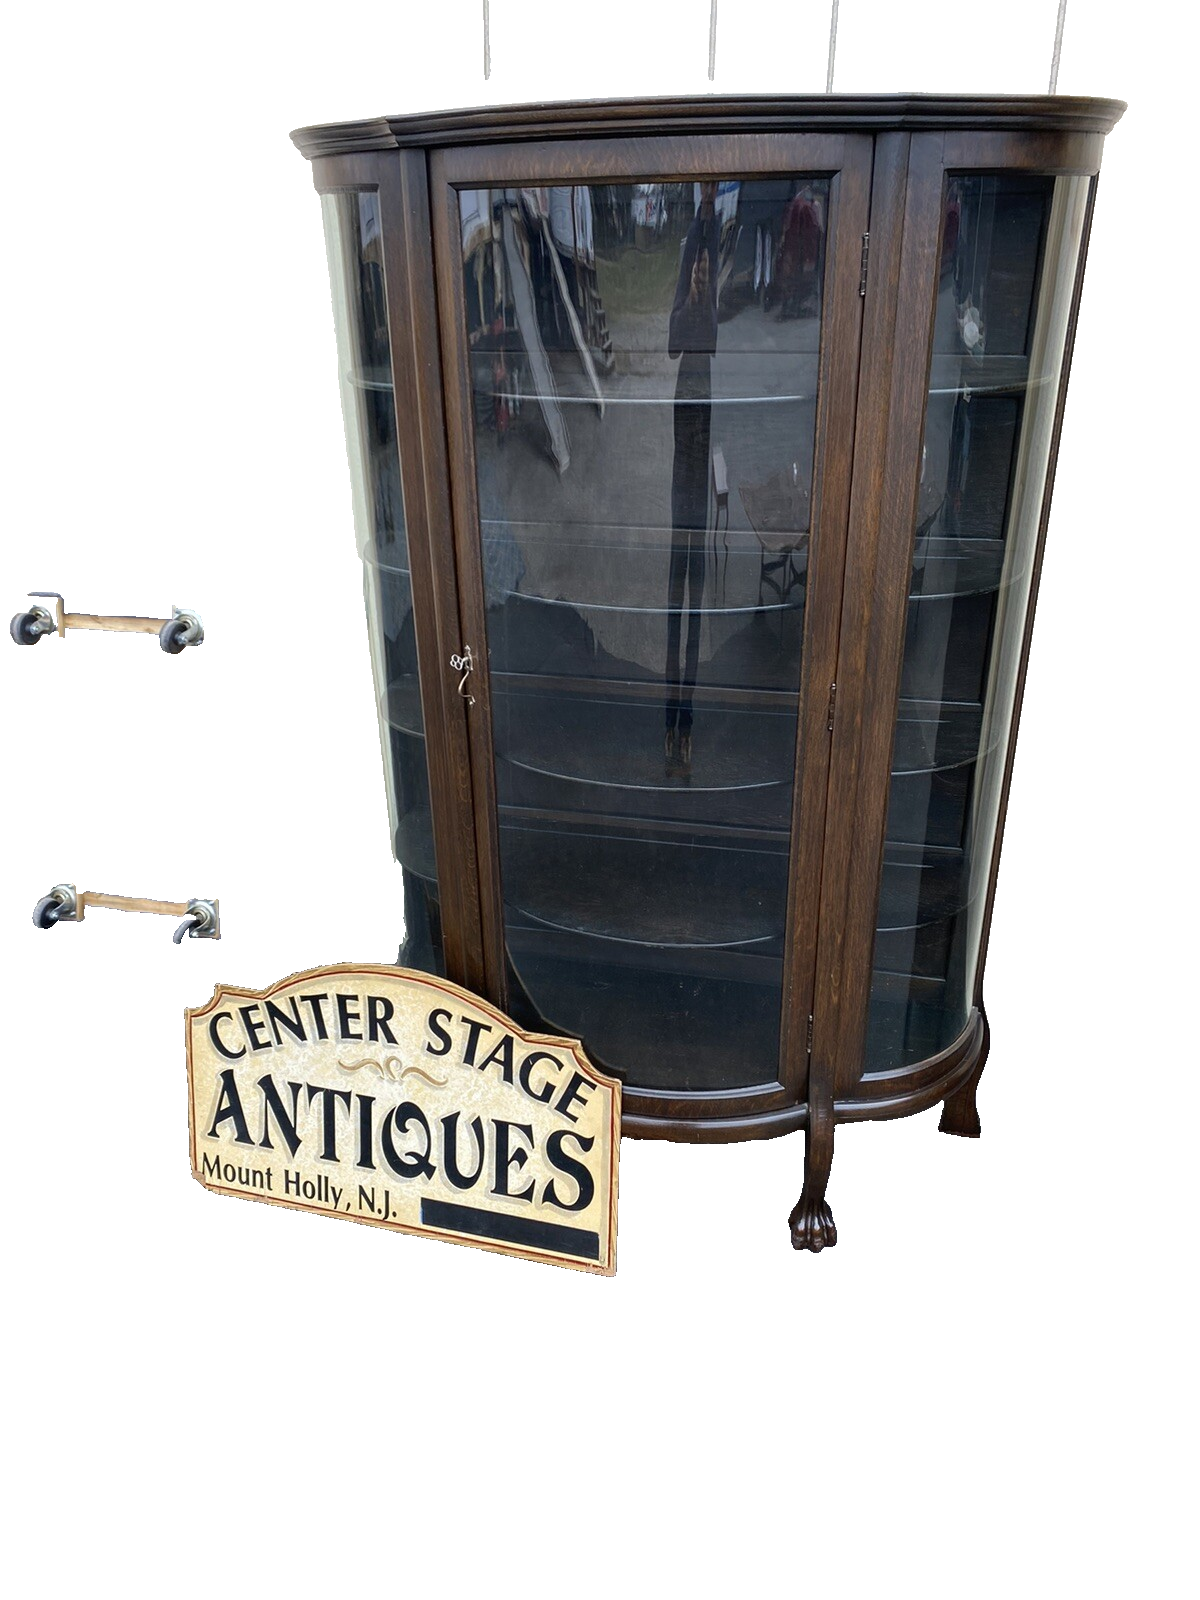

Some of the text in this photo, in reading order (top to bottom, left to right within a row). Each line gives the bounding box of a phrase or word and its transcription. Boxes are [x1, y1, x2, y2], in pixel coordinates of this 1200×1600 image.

[209, 994, 597, 1123] CENTER STAGE
[202, 1152, 398, 1220] Mount Holly, N.J.
[207, 1068, 595, 1211] ANTIQUES
